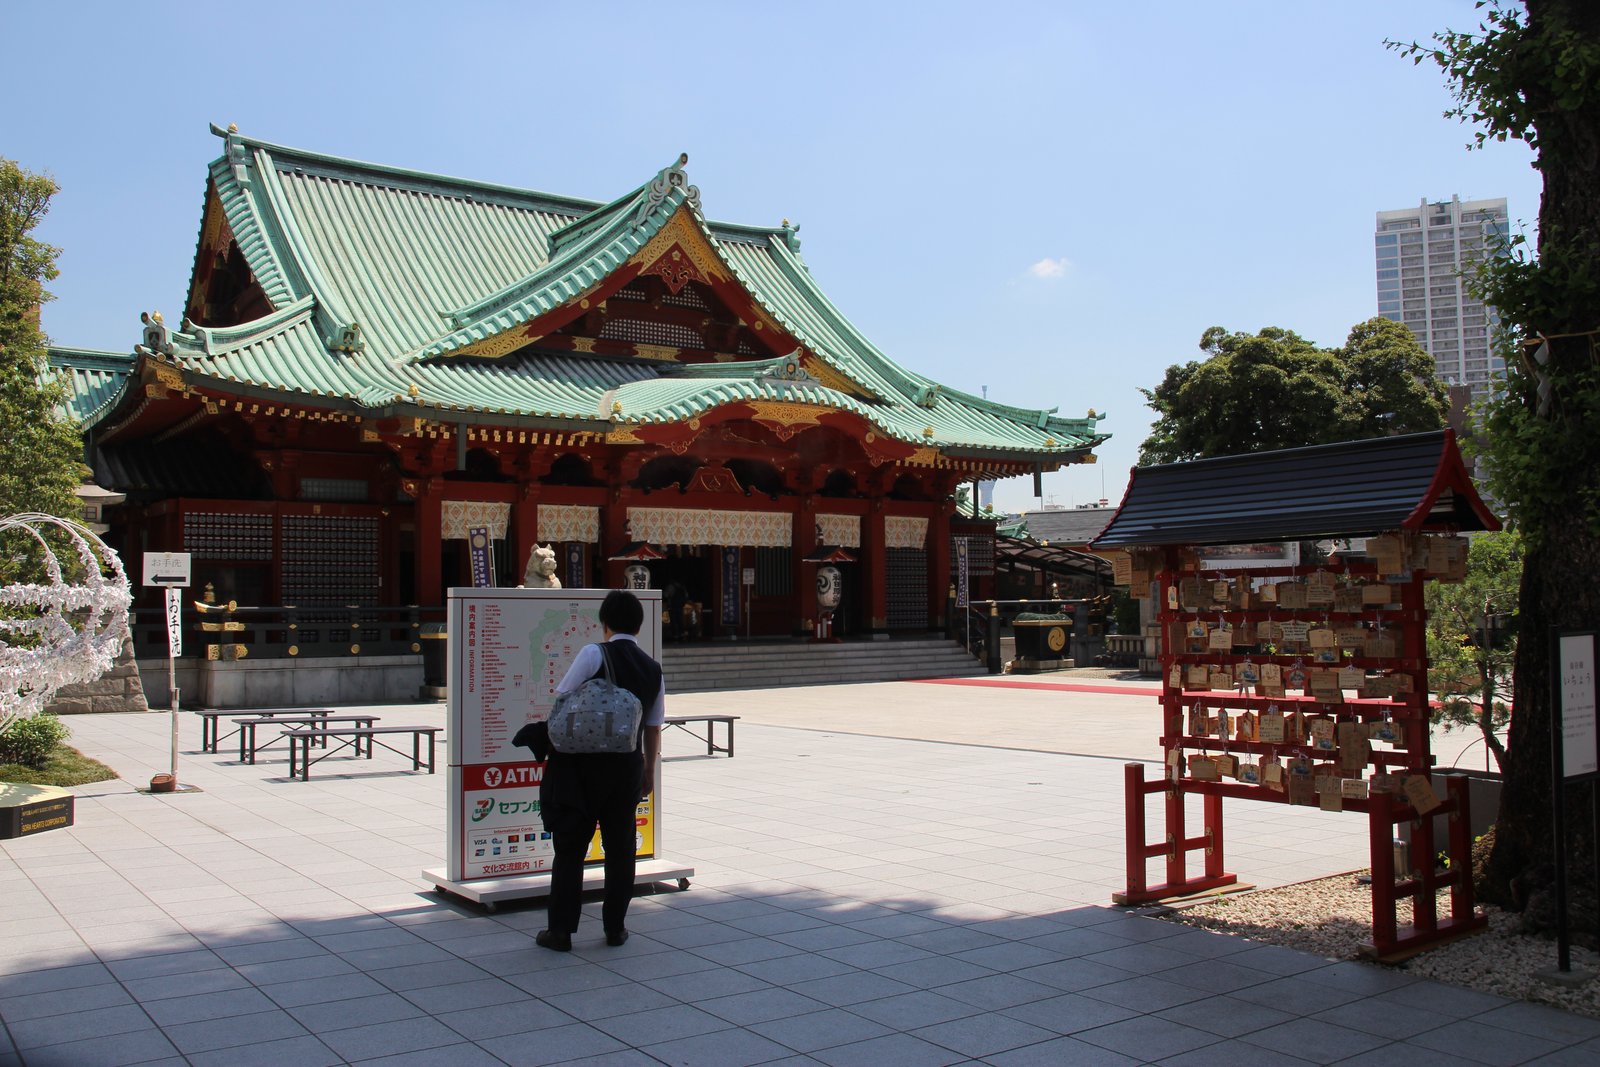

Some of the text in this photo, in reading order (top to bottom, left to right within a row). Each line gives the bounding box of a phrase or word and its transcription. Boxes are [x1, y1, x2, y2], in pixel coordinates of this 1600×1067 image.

[151, 558, 182, 568] お手洗
[168, 594, 181, 655] お手洗
[468, 604, 476, 647] 境内案内図
[504, 766, 543, 784] ATM
[32, 820, 45, 830] HEARTS
[45, 817, 66, 826] CORPORATION
[482, 859, 544, 874] 文化交流館内 1F
